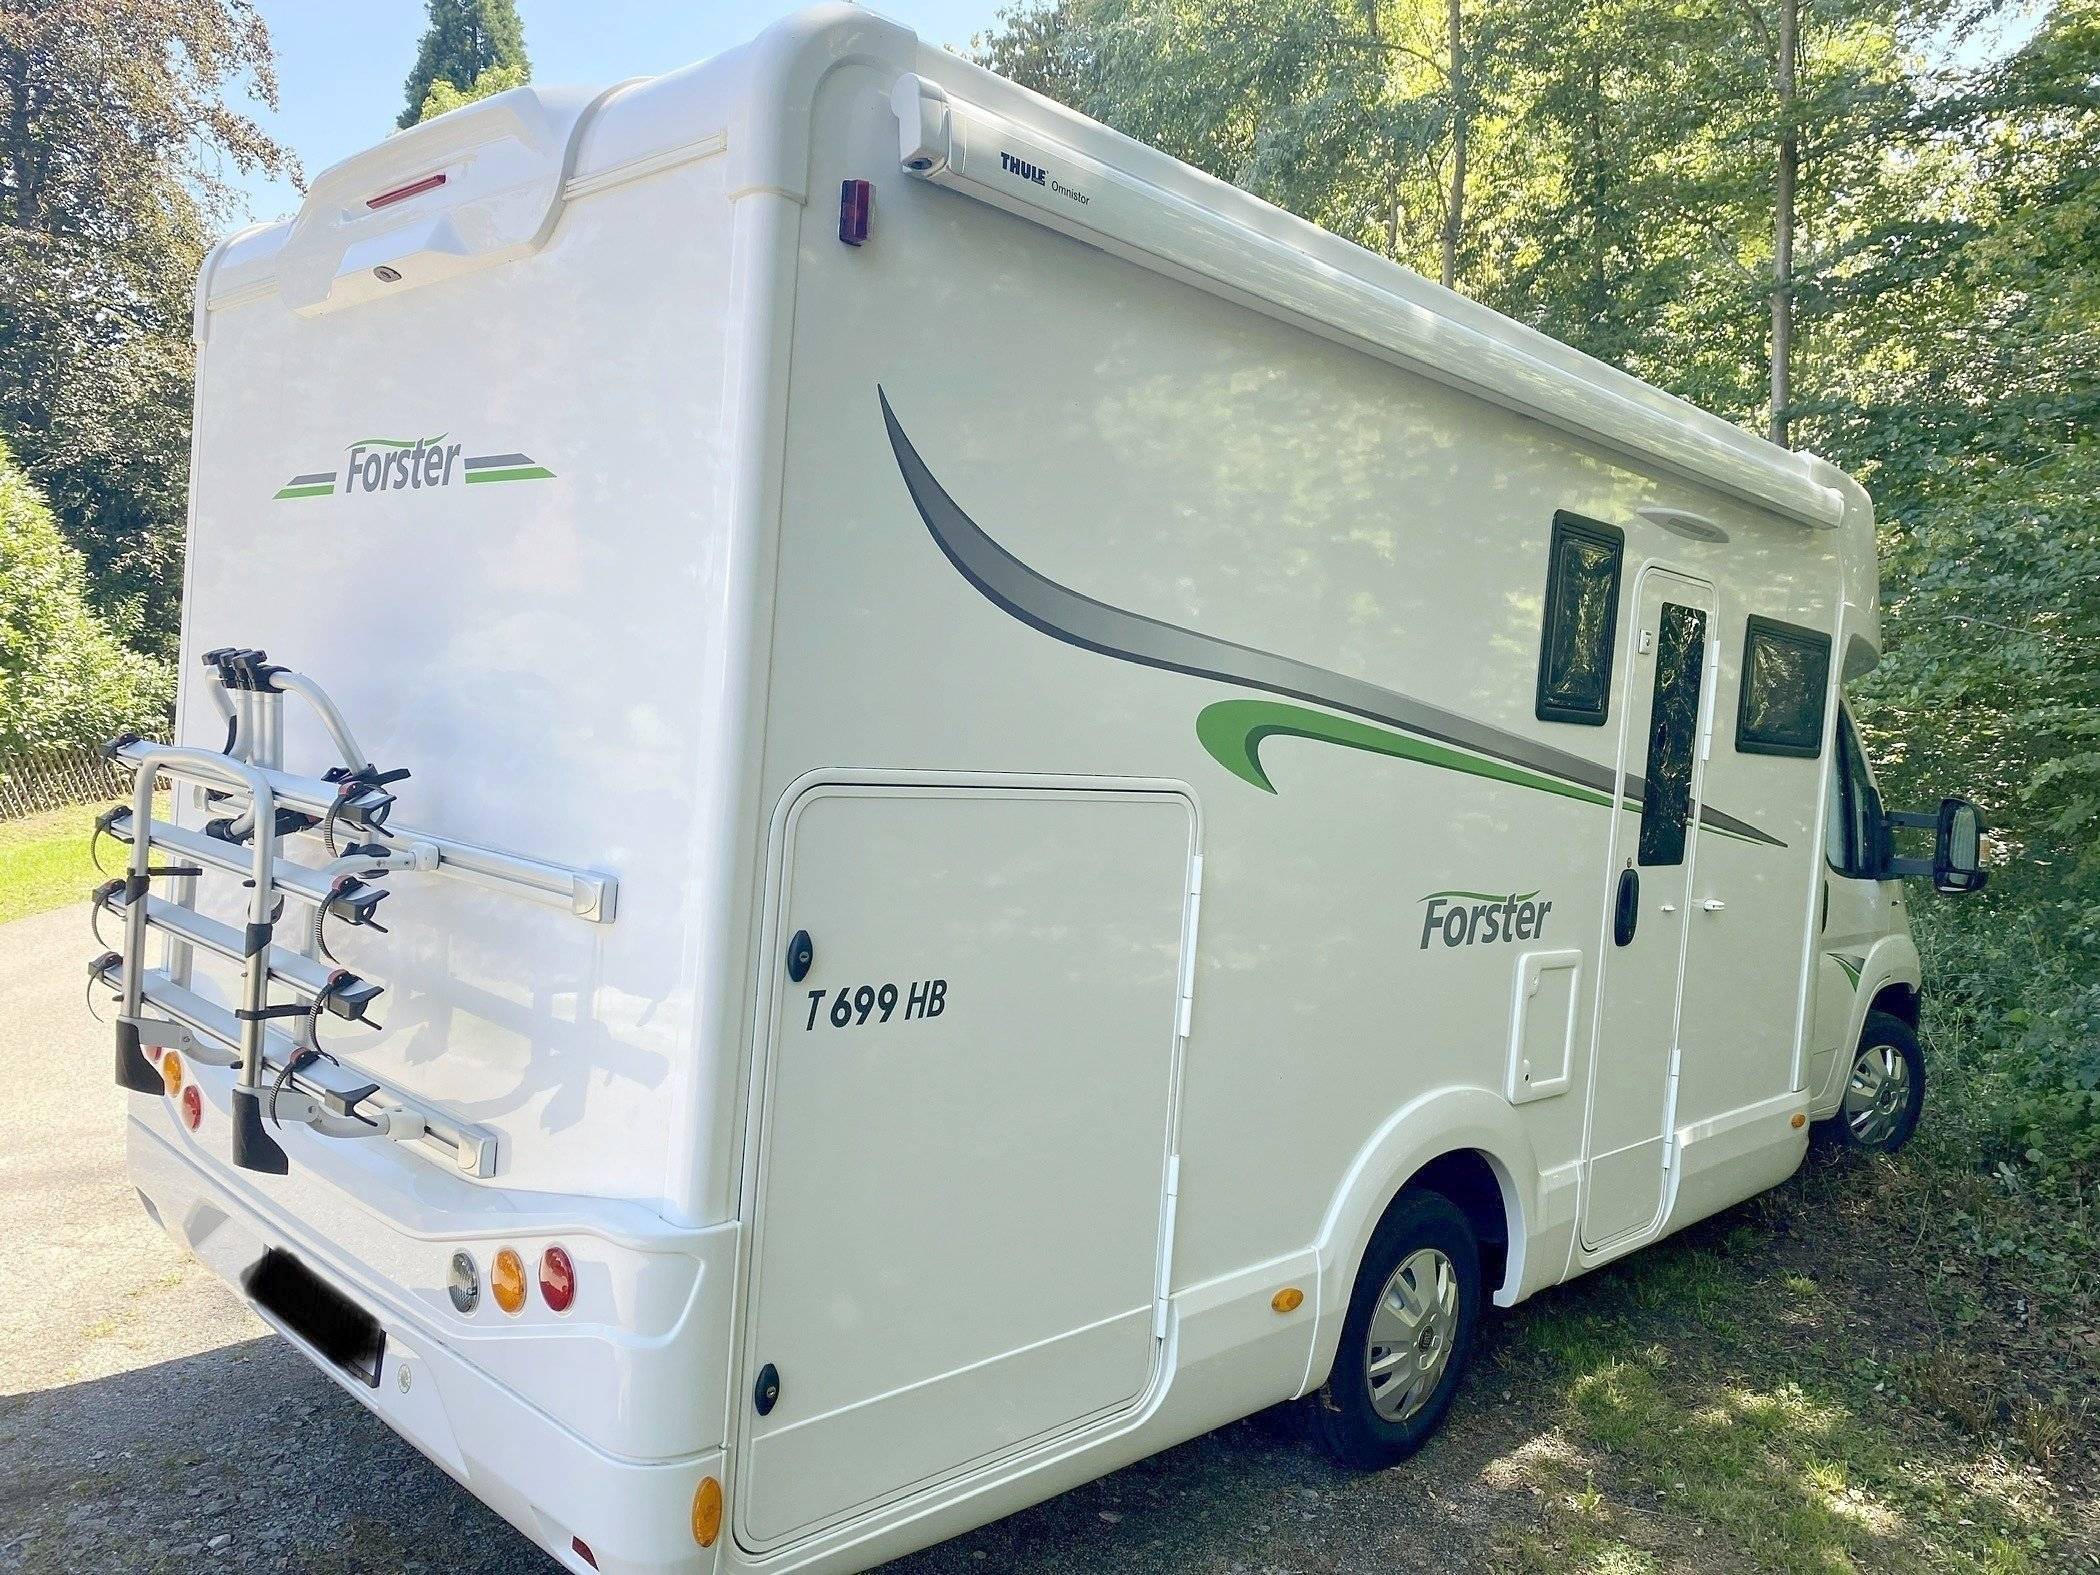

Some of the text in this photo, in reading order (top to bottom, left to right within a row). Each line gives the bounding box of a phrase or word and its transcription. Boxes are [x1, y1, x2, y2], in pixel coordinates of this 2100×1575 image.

[1000, 151, 1090, 205] THULE Omnistor
[346, 437, 461, 493] Forster
[1420, 893, 1552, 949] Forster
[806, 979, 948, 1031] T 699 HB
